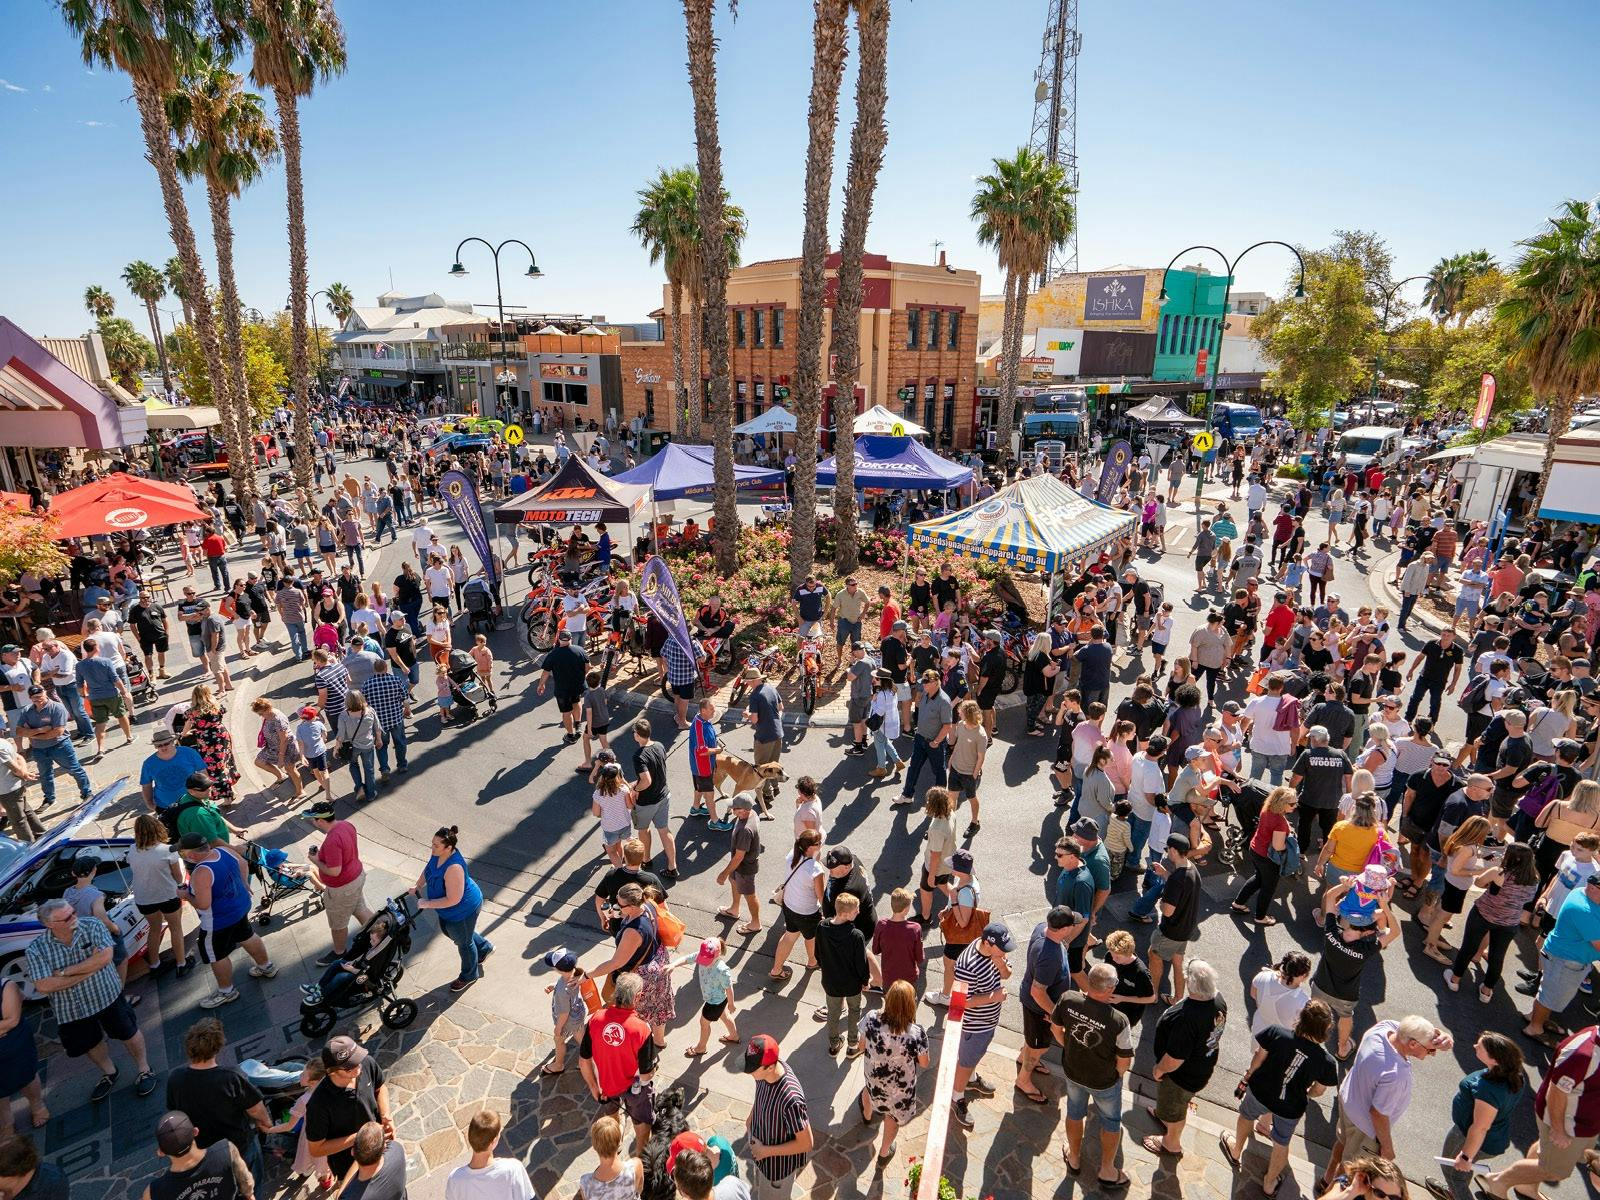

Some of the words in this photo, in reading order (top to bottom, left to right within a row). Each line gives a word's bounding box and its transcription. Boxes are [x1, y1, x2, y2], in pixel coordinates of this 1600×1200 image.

[1092, 298, 1134, 312] ISHKA
[1046, 341, 1075, 351] SUBWAY
[539, 487, 597, 501] KTM
[525, 510, 601, 521] MOTOTECH
[912, 532, 1047, 566] exposedsignageandapparel.com.au
[1310, 759, 1343, 768] WOODY!
[1067, 1007, 1080, 1017] ISLE
[1089, 1018, 1106, 1030] MAN
